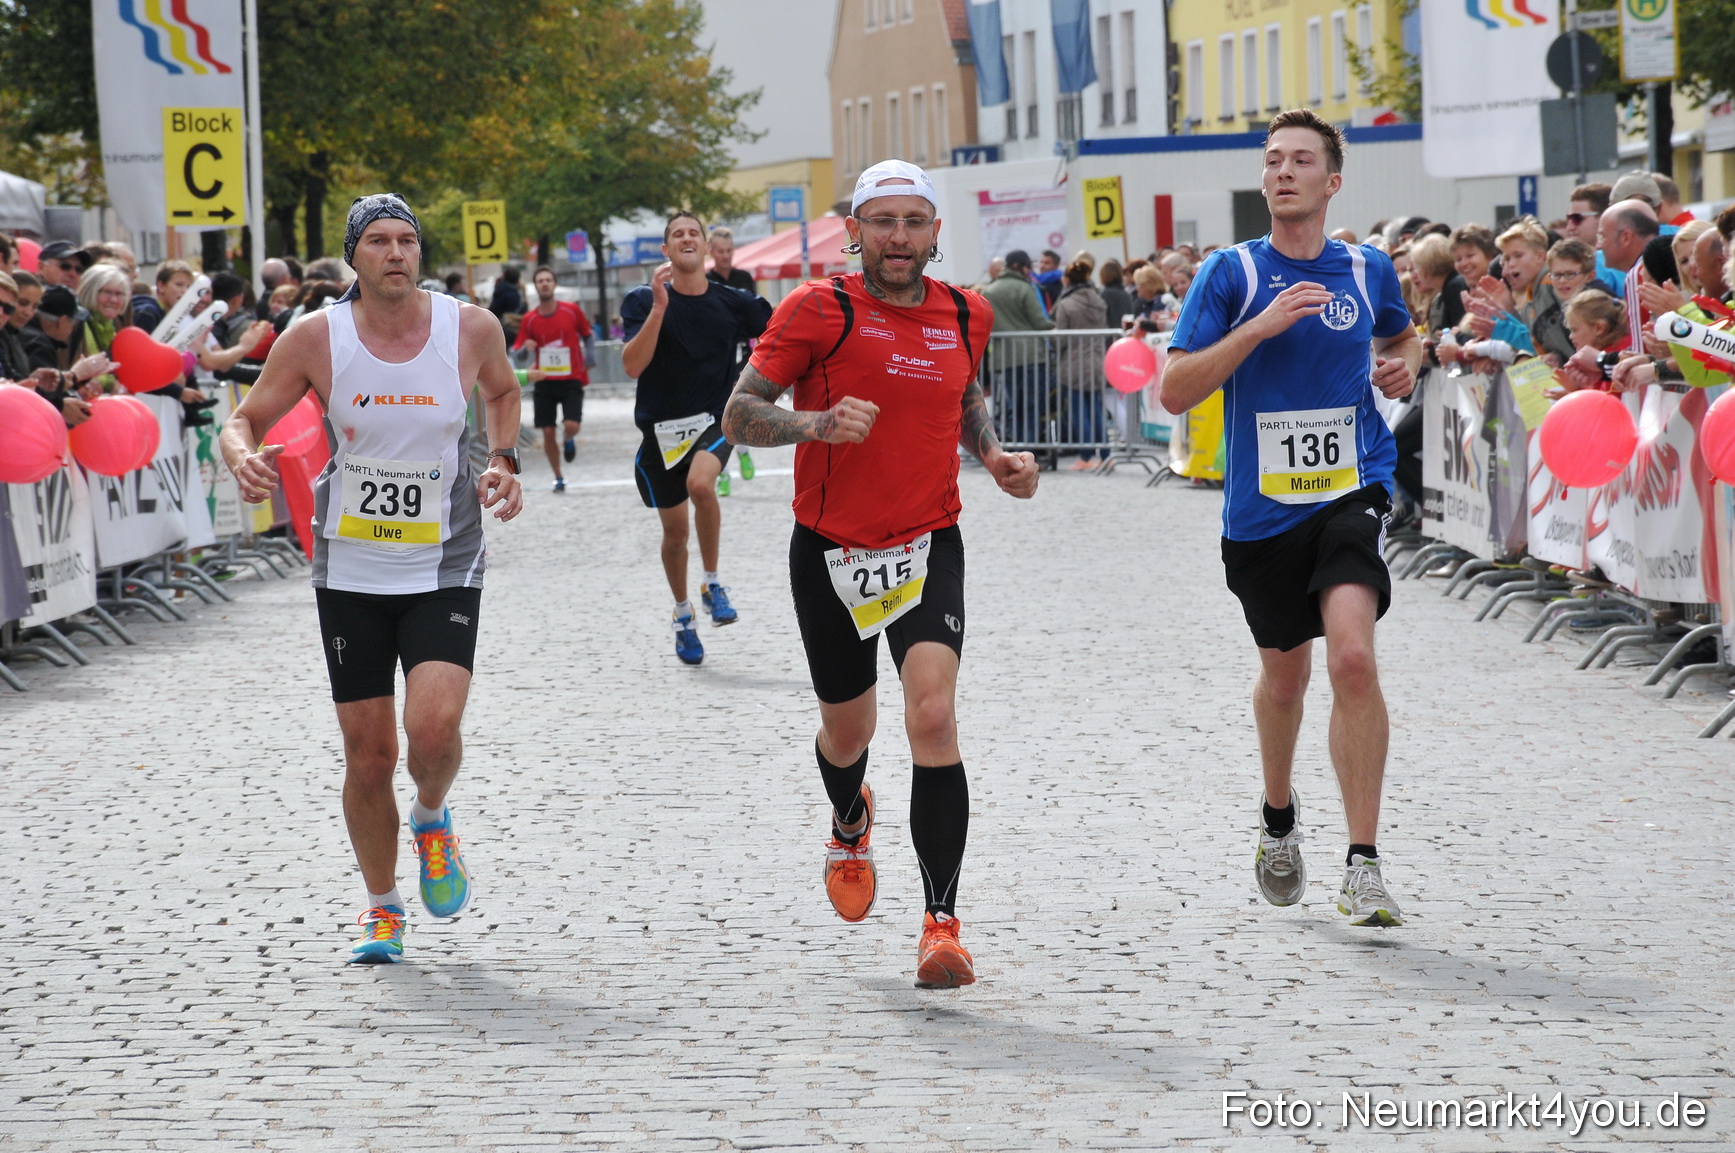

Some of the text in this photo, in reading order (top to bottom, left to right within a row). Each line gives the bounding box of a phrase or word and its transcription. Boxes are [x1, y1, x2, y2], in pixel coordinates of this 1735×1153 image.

[172, 112, 233, 133] Block
[184, 142, 224, 200] C
[1086, 179, 1118, 193] Block
[468, 204, 499, 216] Block
[1094, 196, 1115, 226] D
[475, 220, 496, 250] D
[549, 355, 562, 365] 15
[892, 353, 935, 368] Gruber
[374, 395, 440, 406] KLEBL
[1260, 418, 1342, 431] PARTL Neumarkt
[1280, 432, 1340, 468] 136
[344, 462, 426, 480] PARTL Neumarkt
[1291, 476, 1331, 491] Martin
[359, 480, 422, 518] 239
[373, 525, 402, 539] Uwe
[829, 554, 864, 570] PARTL
[852, 558, 912, 599] 215
[881, 591, 902, 614] Reini
